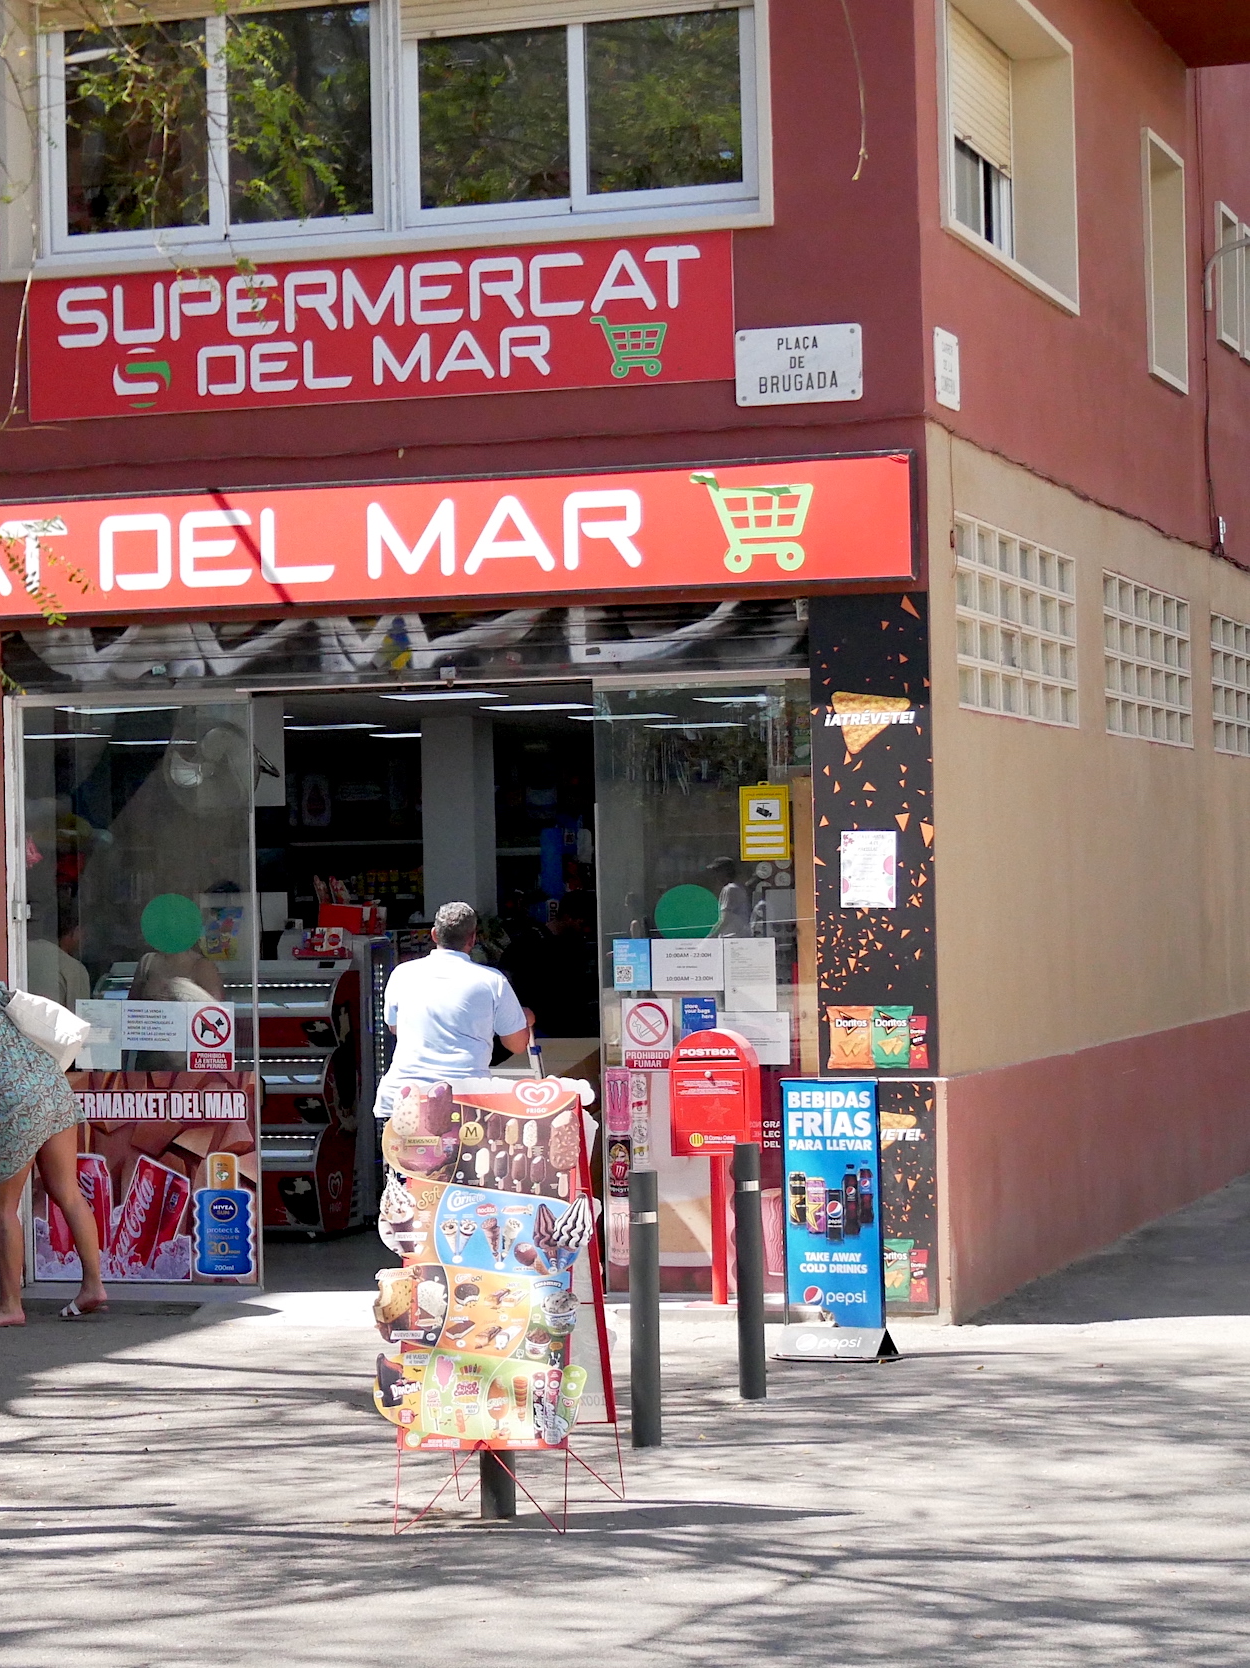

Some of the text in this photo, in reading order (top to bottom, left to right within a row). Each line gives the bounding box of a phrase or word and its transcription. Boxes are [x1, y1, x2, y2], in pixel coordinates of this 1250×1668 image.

[56, 243, 701, 349] SUPERMERCAT
[777, 336, 818, 351] PLAÇA
[196, 324, 551, 397] DEL MAR
[789, 356, 805, 369] DE
[758, 370, 838, 395] BRUGADA
[99, 508, 336, 593] DEL
[366, 488, 643, 580] MAR
[824, 710, 915, 727] ¡ATRÉVETE!
[835, 1018, 868, 1027] Doritos
[874, 1018, 907, 1027] Doritos
[626, 1051, 670, 1060] PROHIBIDO
[679, 1048, 737, 1056] POSTBOX
[633, 1060, 662, 1068] FUMAR
[75, 1092, 246, 1119] ERMARKET DEL MAR
[787, 1090, 871, 1109] BEBIDAS
[787, 1108, 872, 1138] FRÍAS
[788, 1139, 873, 1151] PARA LLEVAR
[206, 1227, 233, 1235] protect
[207, 1241, 229, 1255] 30
[804, 1252, 862, 1262] TAKE AWAY
[883, 1251, 908, 1260] oritos
[799, 1263, 868, 1274] COLD DRINKS
[825, 1290, 867, 1305] pepsi
[817, 1336, 863, 1350] pepsi
